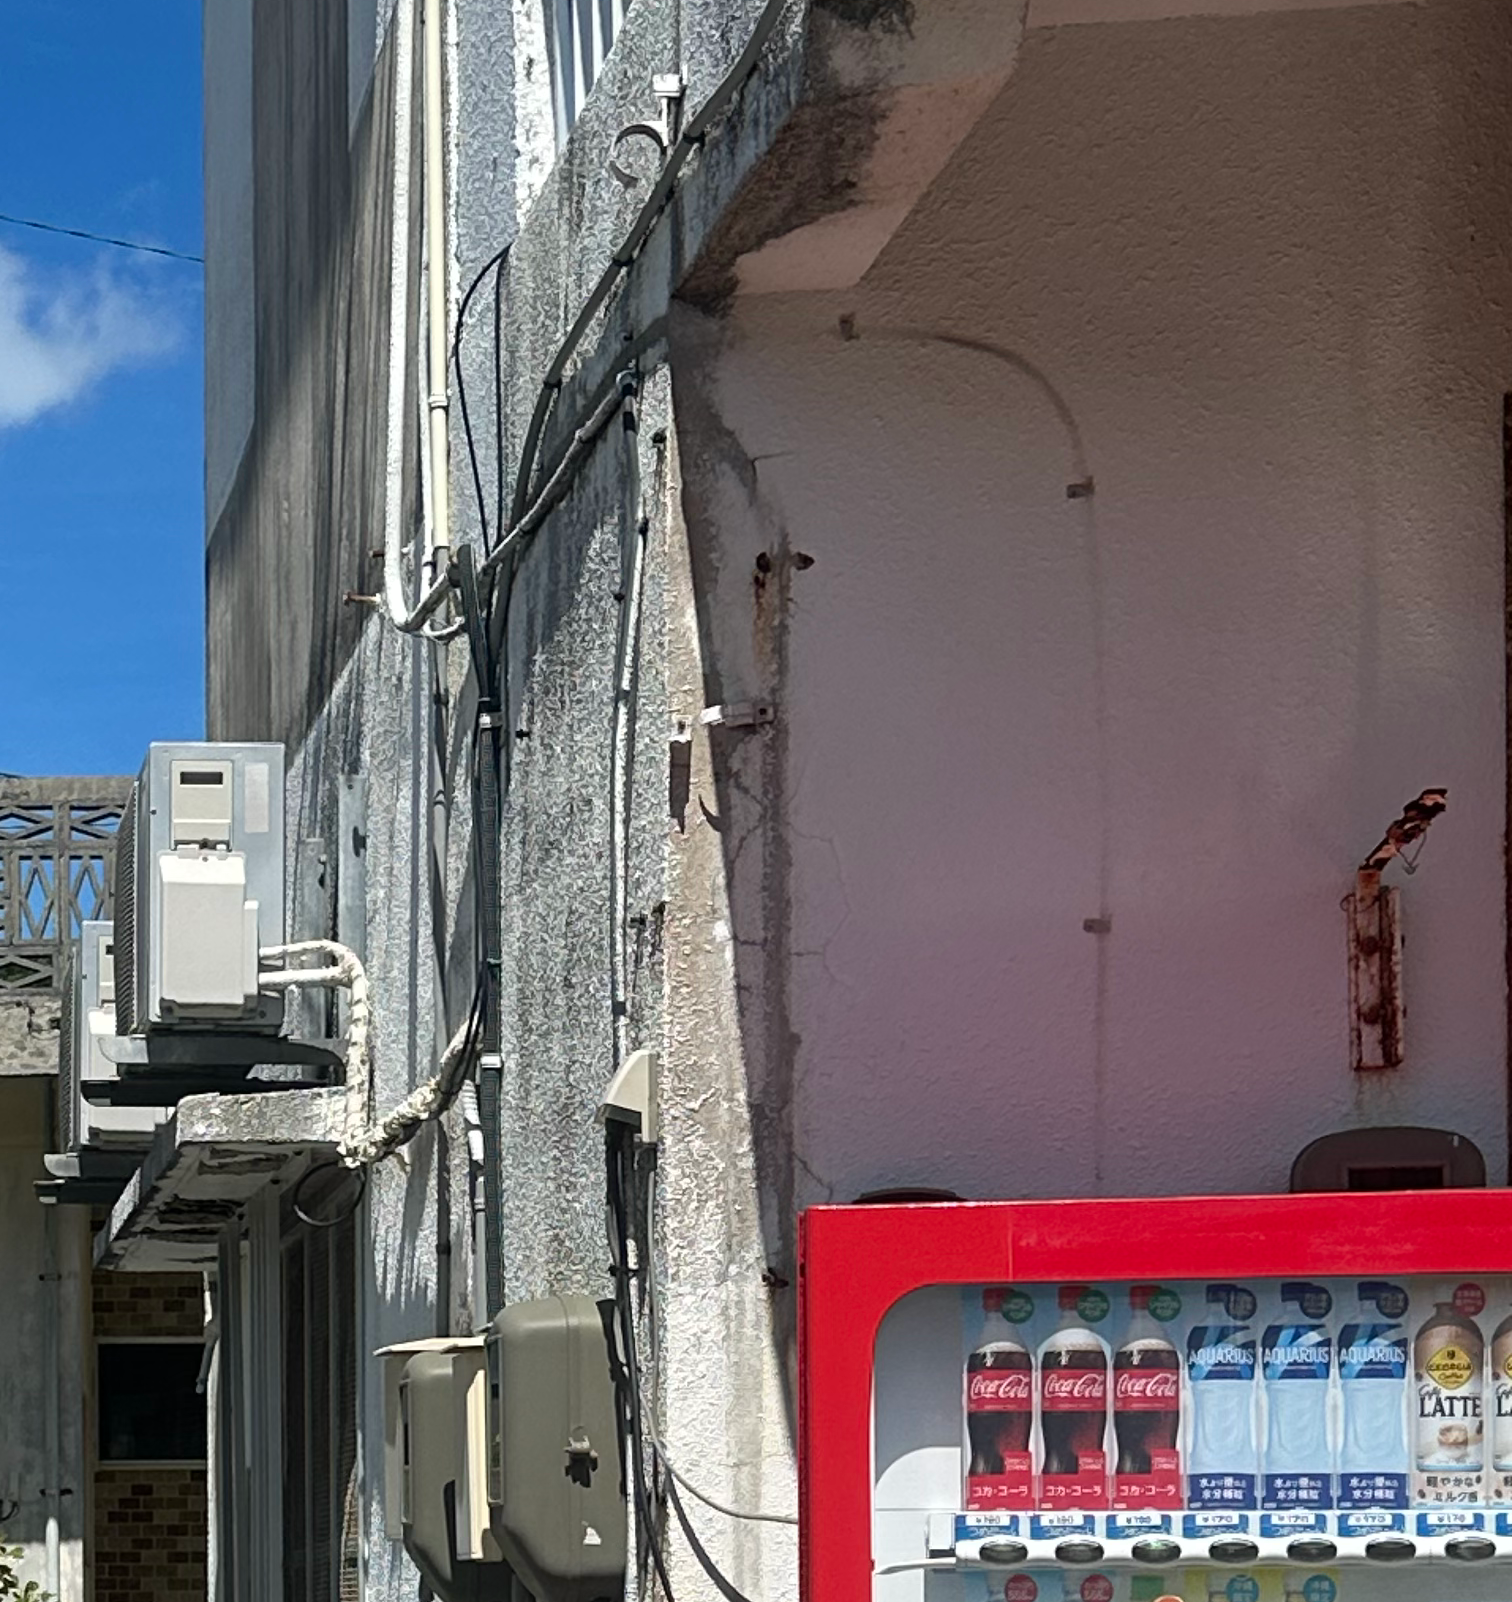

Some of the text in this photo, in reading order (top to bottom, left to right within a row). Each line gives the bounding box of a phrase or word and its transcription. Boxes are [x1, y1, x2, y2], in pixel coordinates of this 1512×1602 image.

[1189, 1346, 1254, 1365] AQUARIUS
[1264, 1345, 1330, 1364] AQUARIUS
[1340, 1345, 1406, 1364] AQUARIUS
[1419, 1396, 1482, 1417] LATTE
